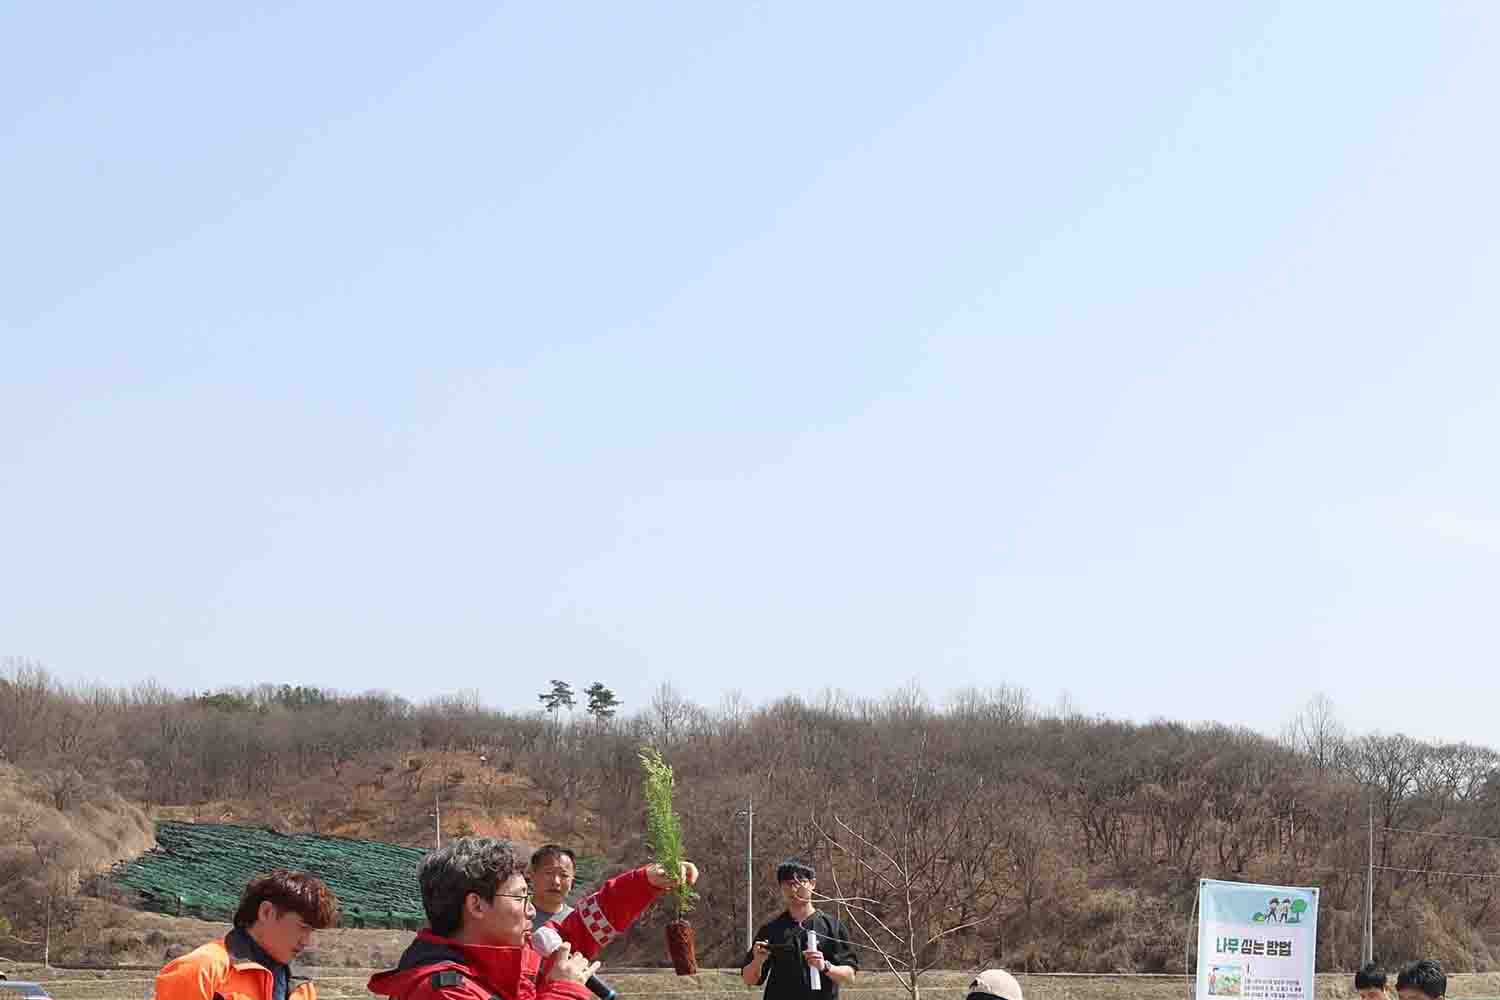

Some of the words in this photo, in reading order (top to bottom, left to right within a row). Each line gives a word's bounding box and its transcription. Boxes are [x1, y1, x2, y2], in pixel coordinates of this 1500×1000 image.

[1216, 936, 1239, 954] 나무
[1241, 938, 1264, 955] 심는
[1267, 940, 1292, 957] 방법
